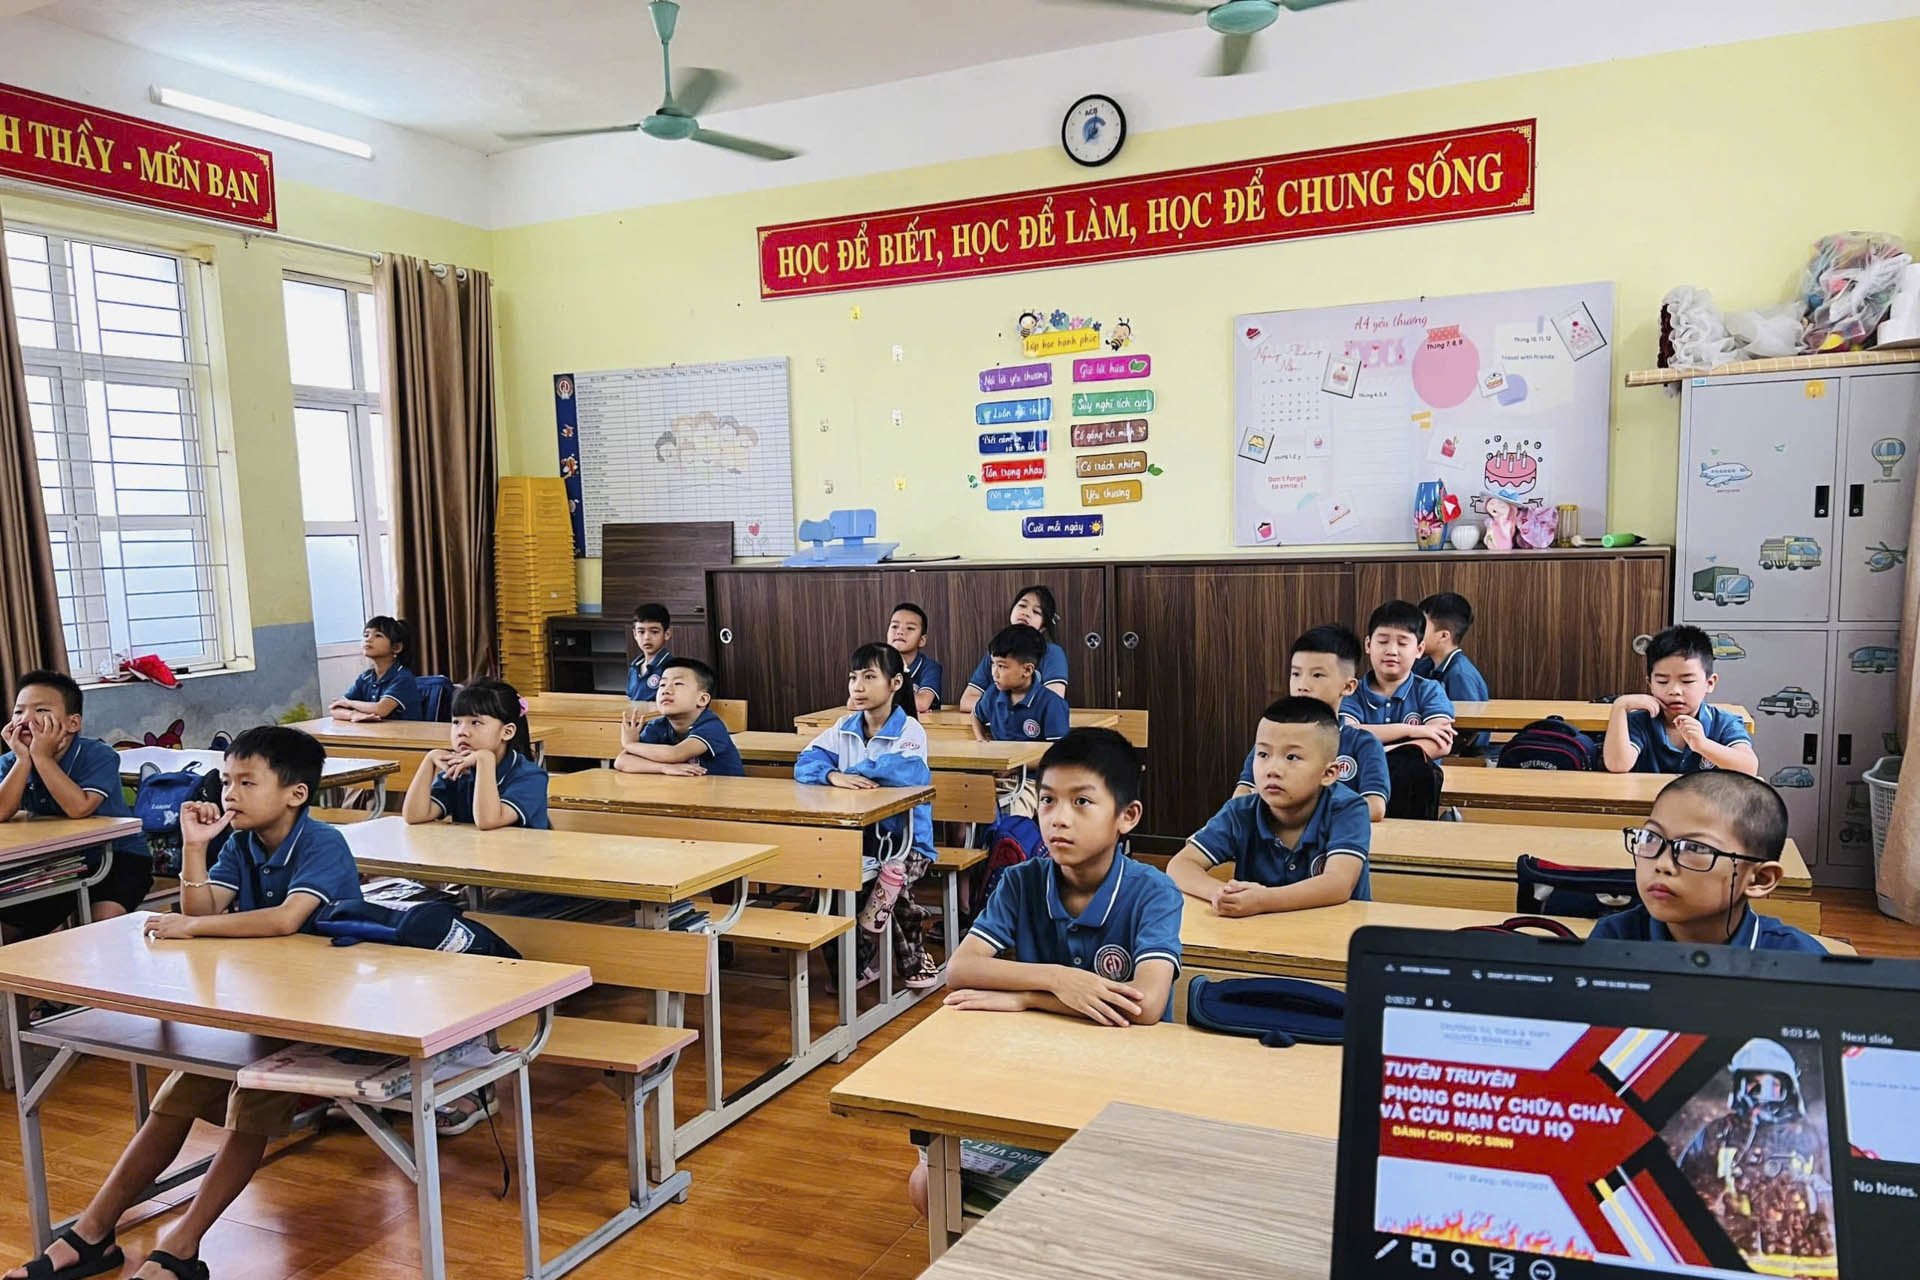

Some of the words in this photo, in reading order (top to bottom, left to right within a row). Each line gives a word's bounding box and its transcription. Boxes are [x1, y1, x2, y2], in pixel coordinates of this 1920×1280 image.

[28, 118, 115, 173] THẦY
[138, 141, 201, 192] MẾN
[207, 163, 259, 209] BẠN
[778, 242, 830, 283] HỌC
[837, 221, 872, 272] ĐỂ
[878, 216, 944, 267] BIẾT,
[951, 219, 1010, 264] HỌC
[1018, 196, 1057, 249] ĐỂ
[1065, 197, 1137, 245] LÀM,
[1147, 192, 1213, 240] HỌC
[1223, 167, 1265, 224] ĐỂ
[1277, 167, 1395, 217] CHUNG
[1406, 143, 1503, 202] SỐNG
[1520, 760, 1558, 771] SUPERHERO
[1805, 1028, 1821, 1040] SA
[1841, 1031, 1867, 1043] Next
[1867, 1032, 1894, 1045] slide
[1384, 1061, 1443, 1082] TUYÊN
[1453, 1110, 1494, 1132] NẠN
[1427, 1129, 1454, 1142] CHO
[1853, 1178, 1874, 1193] No
[1876, 1181, 1919, 1198] Notes.
